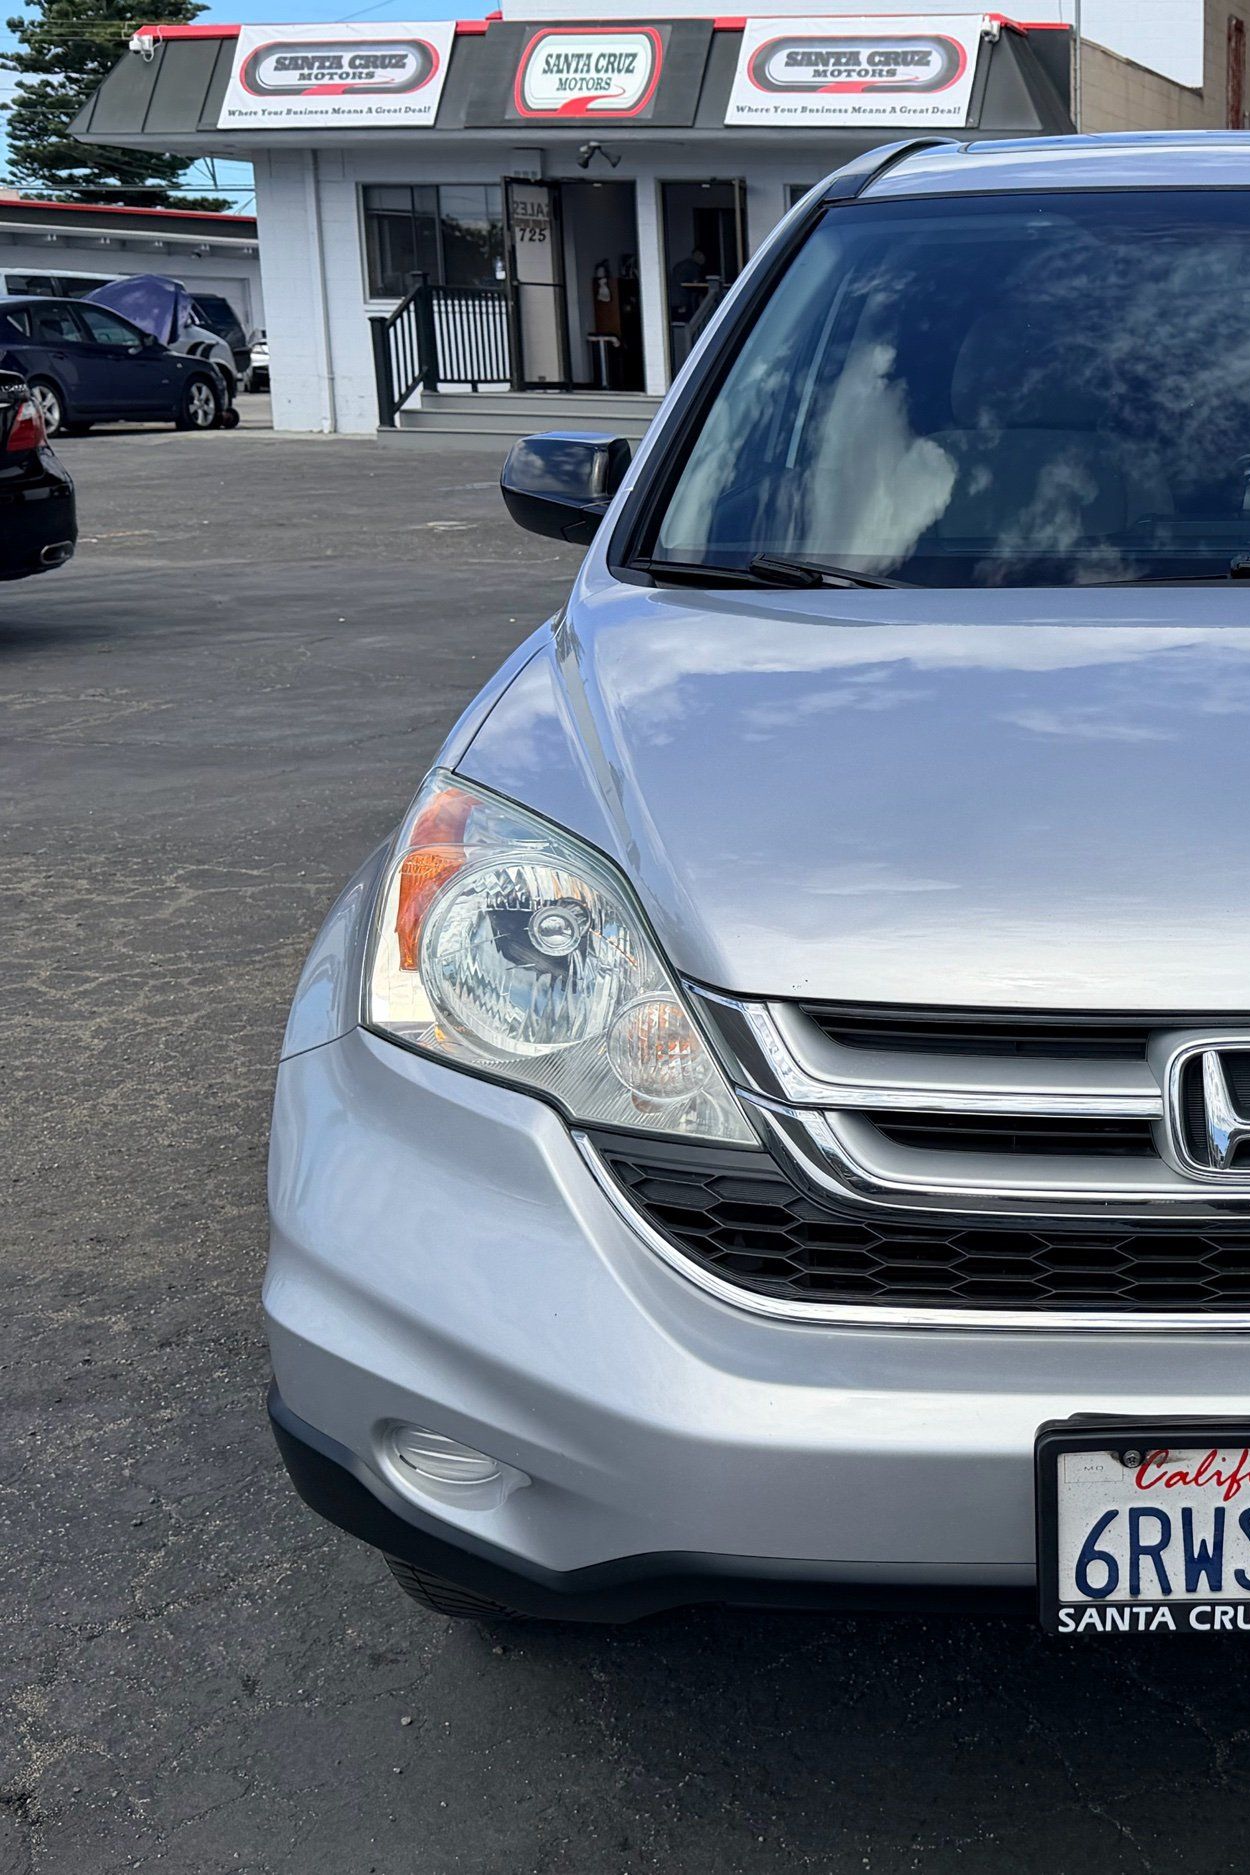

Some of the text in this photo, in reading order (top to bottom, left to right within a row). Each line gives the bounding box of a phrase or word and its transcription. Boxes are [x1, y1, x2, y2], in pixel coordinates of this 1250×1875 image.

[273, 53, 409, 71] SANTA CRUZ
[542, 52, 638, 75] SANTA CRUZ
[784, 50, 933, 67] SANTA CRUZ
[297, 71, 376, 82] MOTORS
[812, 68, 898, 78] MOTORS
[556, 77, 612, 92] MOTORS
[227, 109, 259, 117] Where
[261, 108, 283, 116] Your
[285, 107, 329, 116] Business
[331, 106, 363, 115] Means
[365, 106, 373, 114] A
[375, 105, 402, 114] Great
[736, 105, 961, 115] Where Your Business Means A Great Deal!
[519, 227, 547, 242] 725
[1058, 1607, 1176, 1632] SANTA
